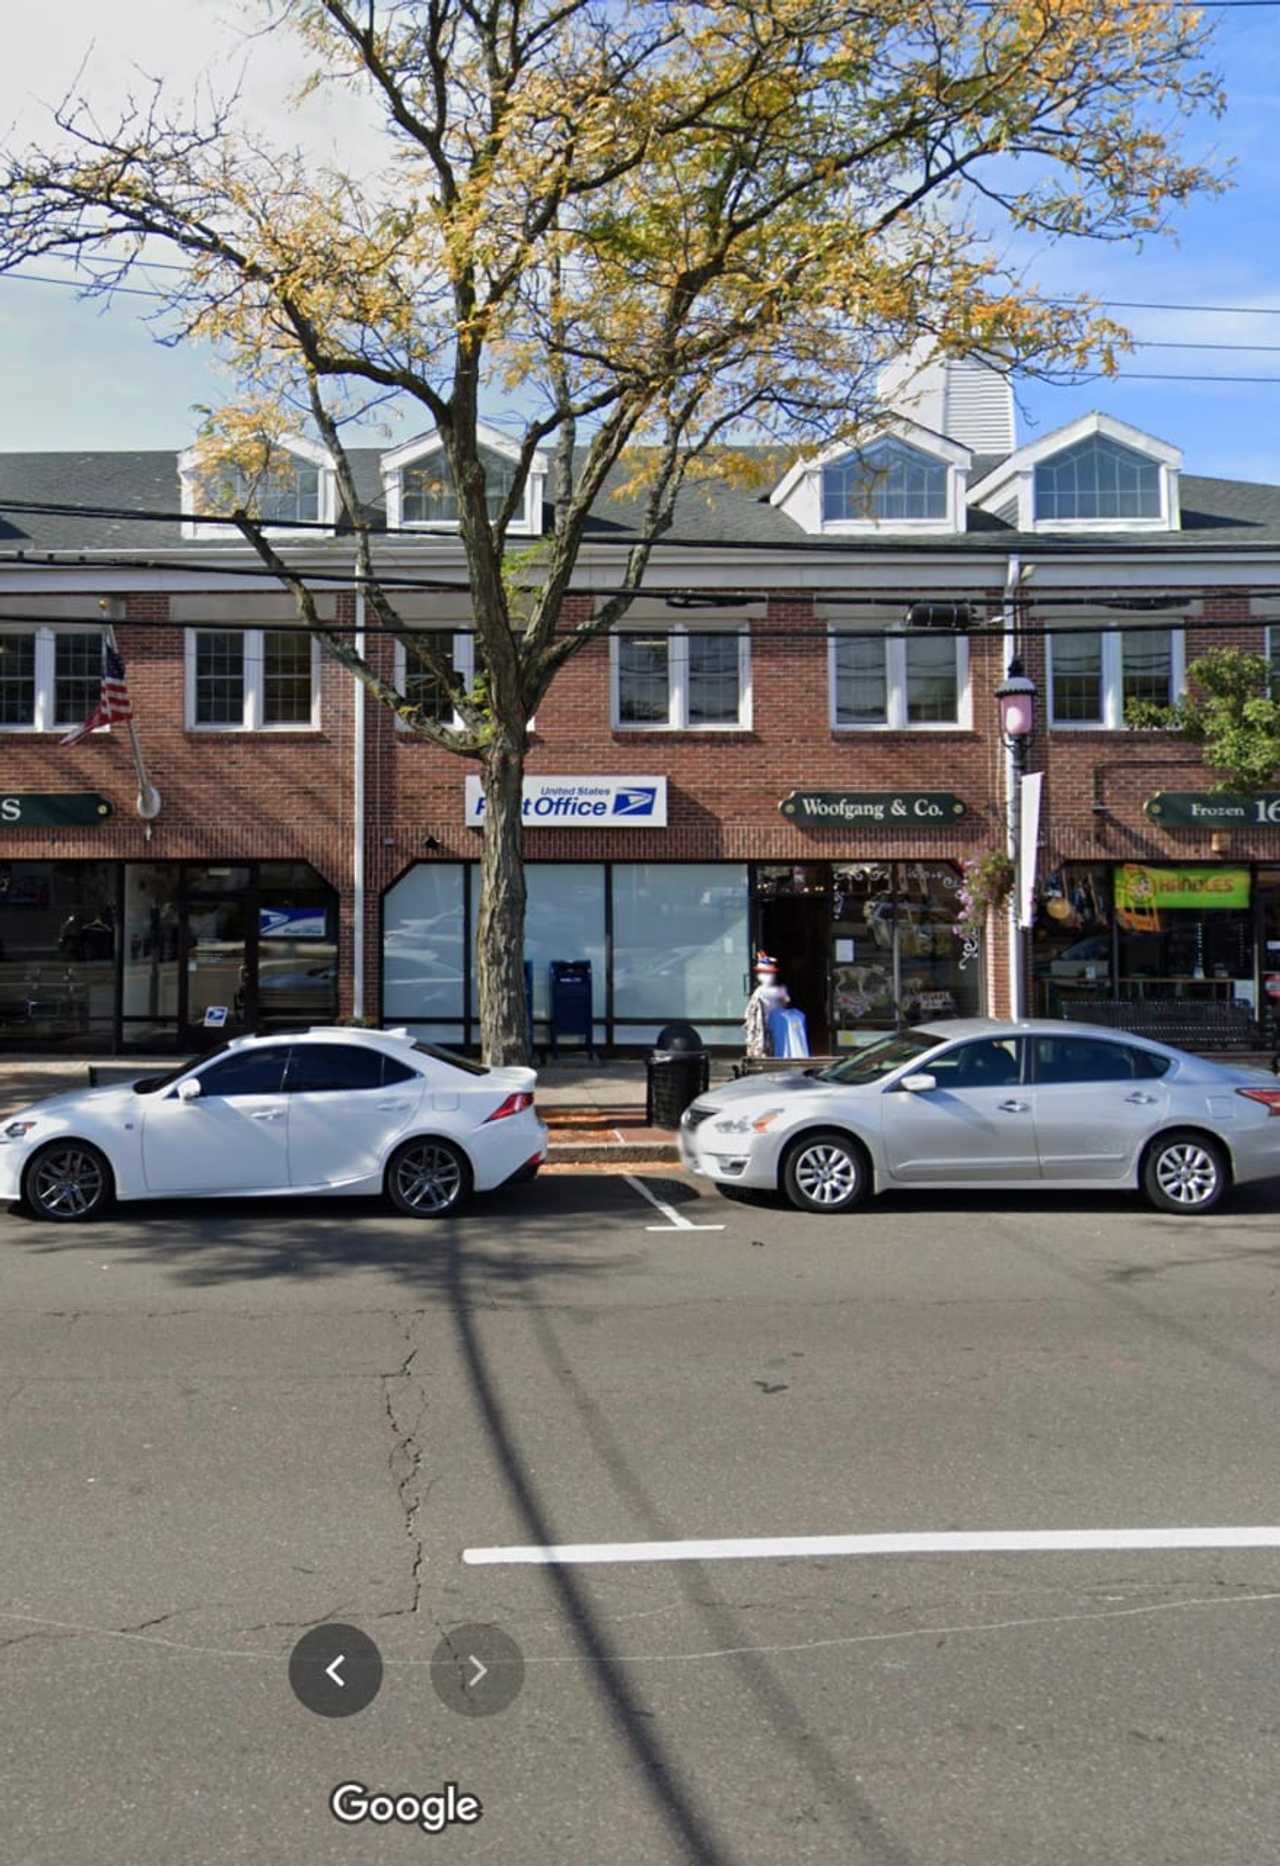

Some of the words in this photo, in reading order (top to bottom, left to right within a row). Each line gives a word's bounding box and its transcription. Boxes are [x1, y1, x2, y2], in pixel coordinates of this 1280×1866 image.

[540, 786, 576, 796] United
[577, 786, 611, 796] States
[475, 796, 532, 816] Pt
[534, 796, 608, 816] Office
[802, 798, 885, 820] Woofgang
[890, 798, 908, 817] &
[913, 798, 944, 817] Co.
[1191, 803, 1246, 817] Frozen
[1255, 799, 1280, 823] 16
